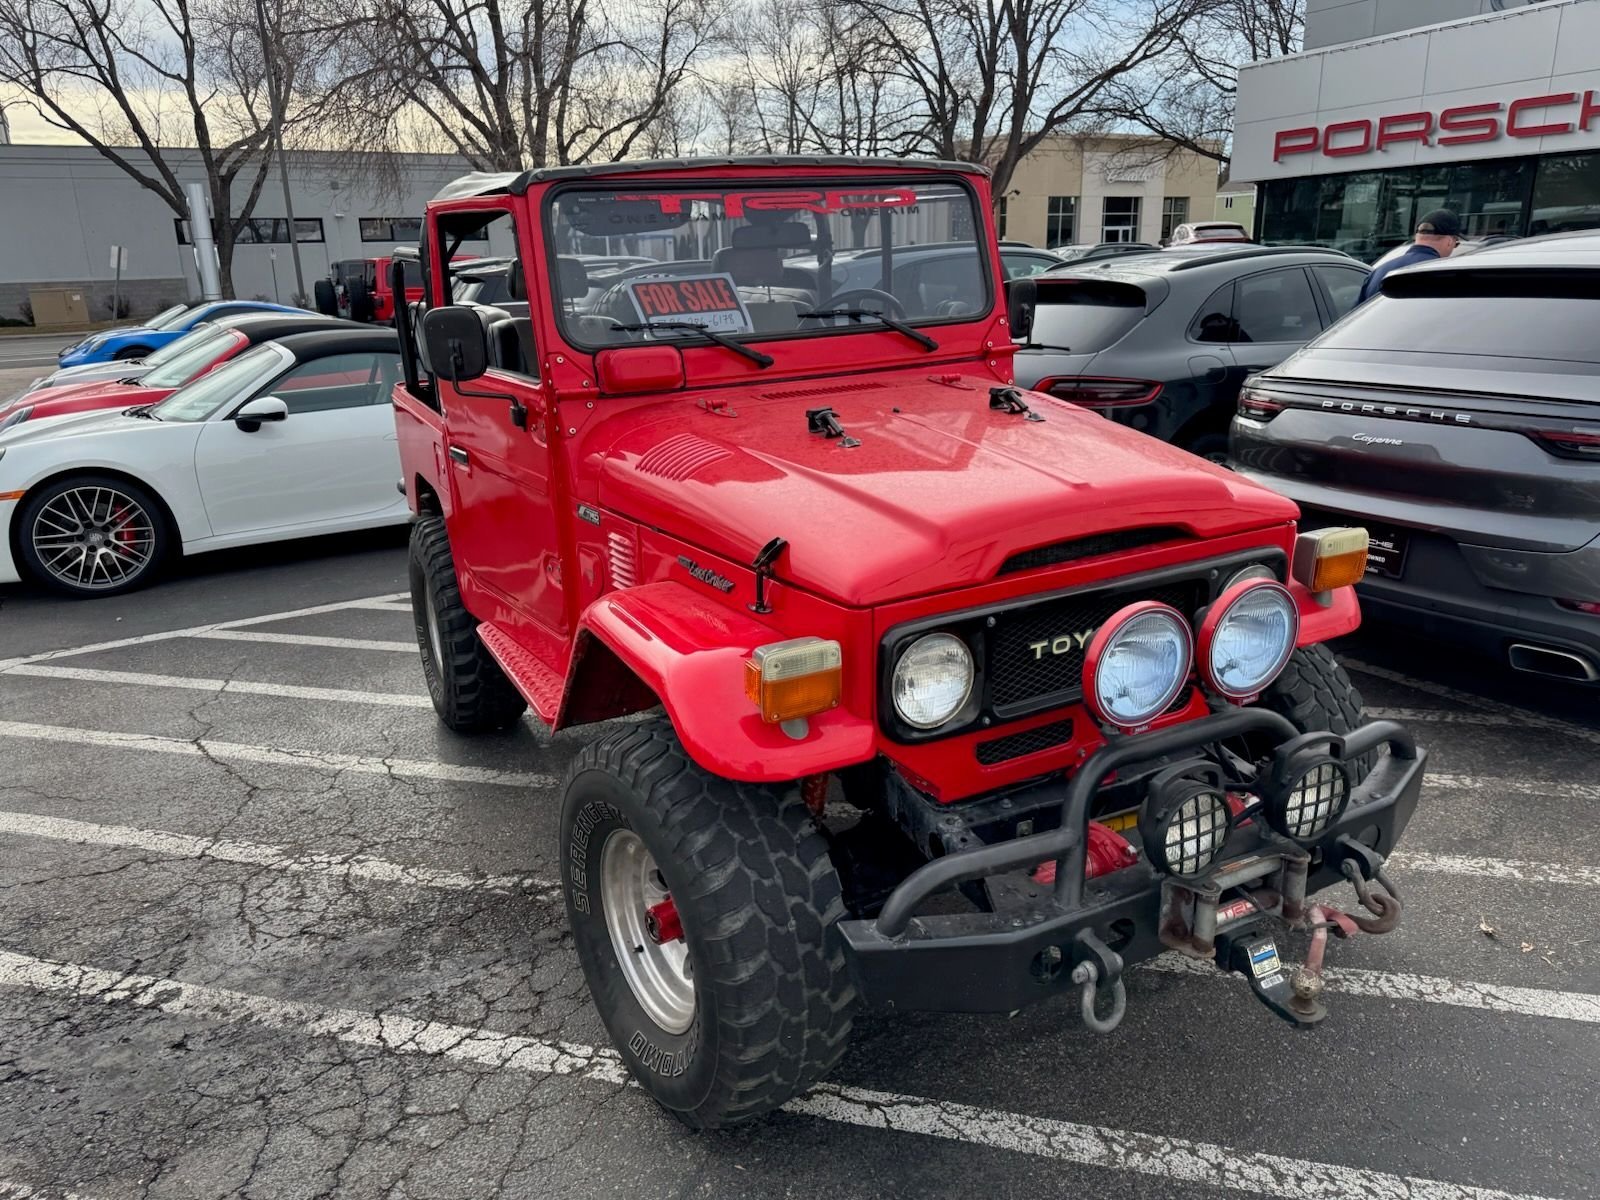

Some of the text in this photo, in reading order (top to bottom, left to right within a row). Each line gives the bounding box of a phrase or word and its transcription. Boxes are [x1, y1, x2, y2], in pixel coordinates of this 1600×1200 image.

[615, 189, 917, 219] TRD
[635, 279, 737, 315] FOR SALE
[1321, 400, 1472, 424] PORSCHE
[1351, 432, 1404, 447] Cayenne
[1029, 628, 1094, 660] TOY
